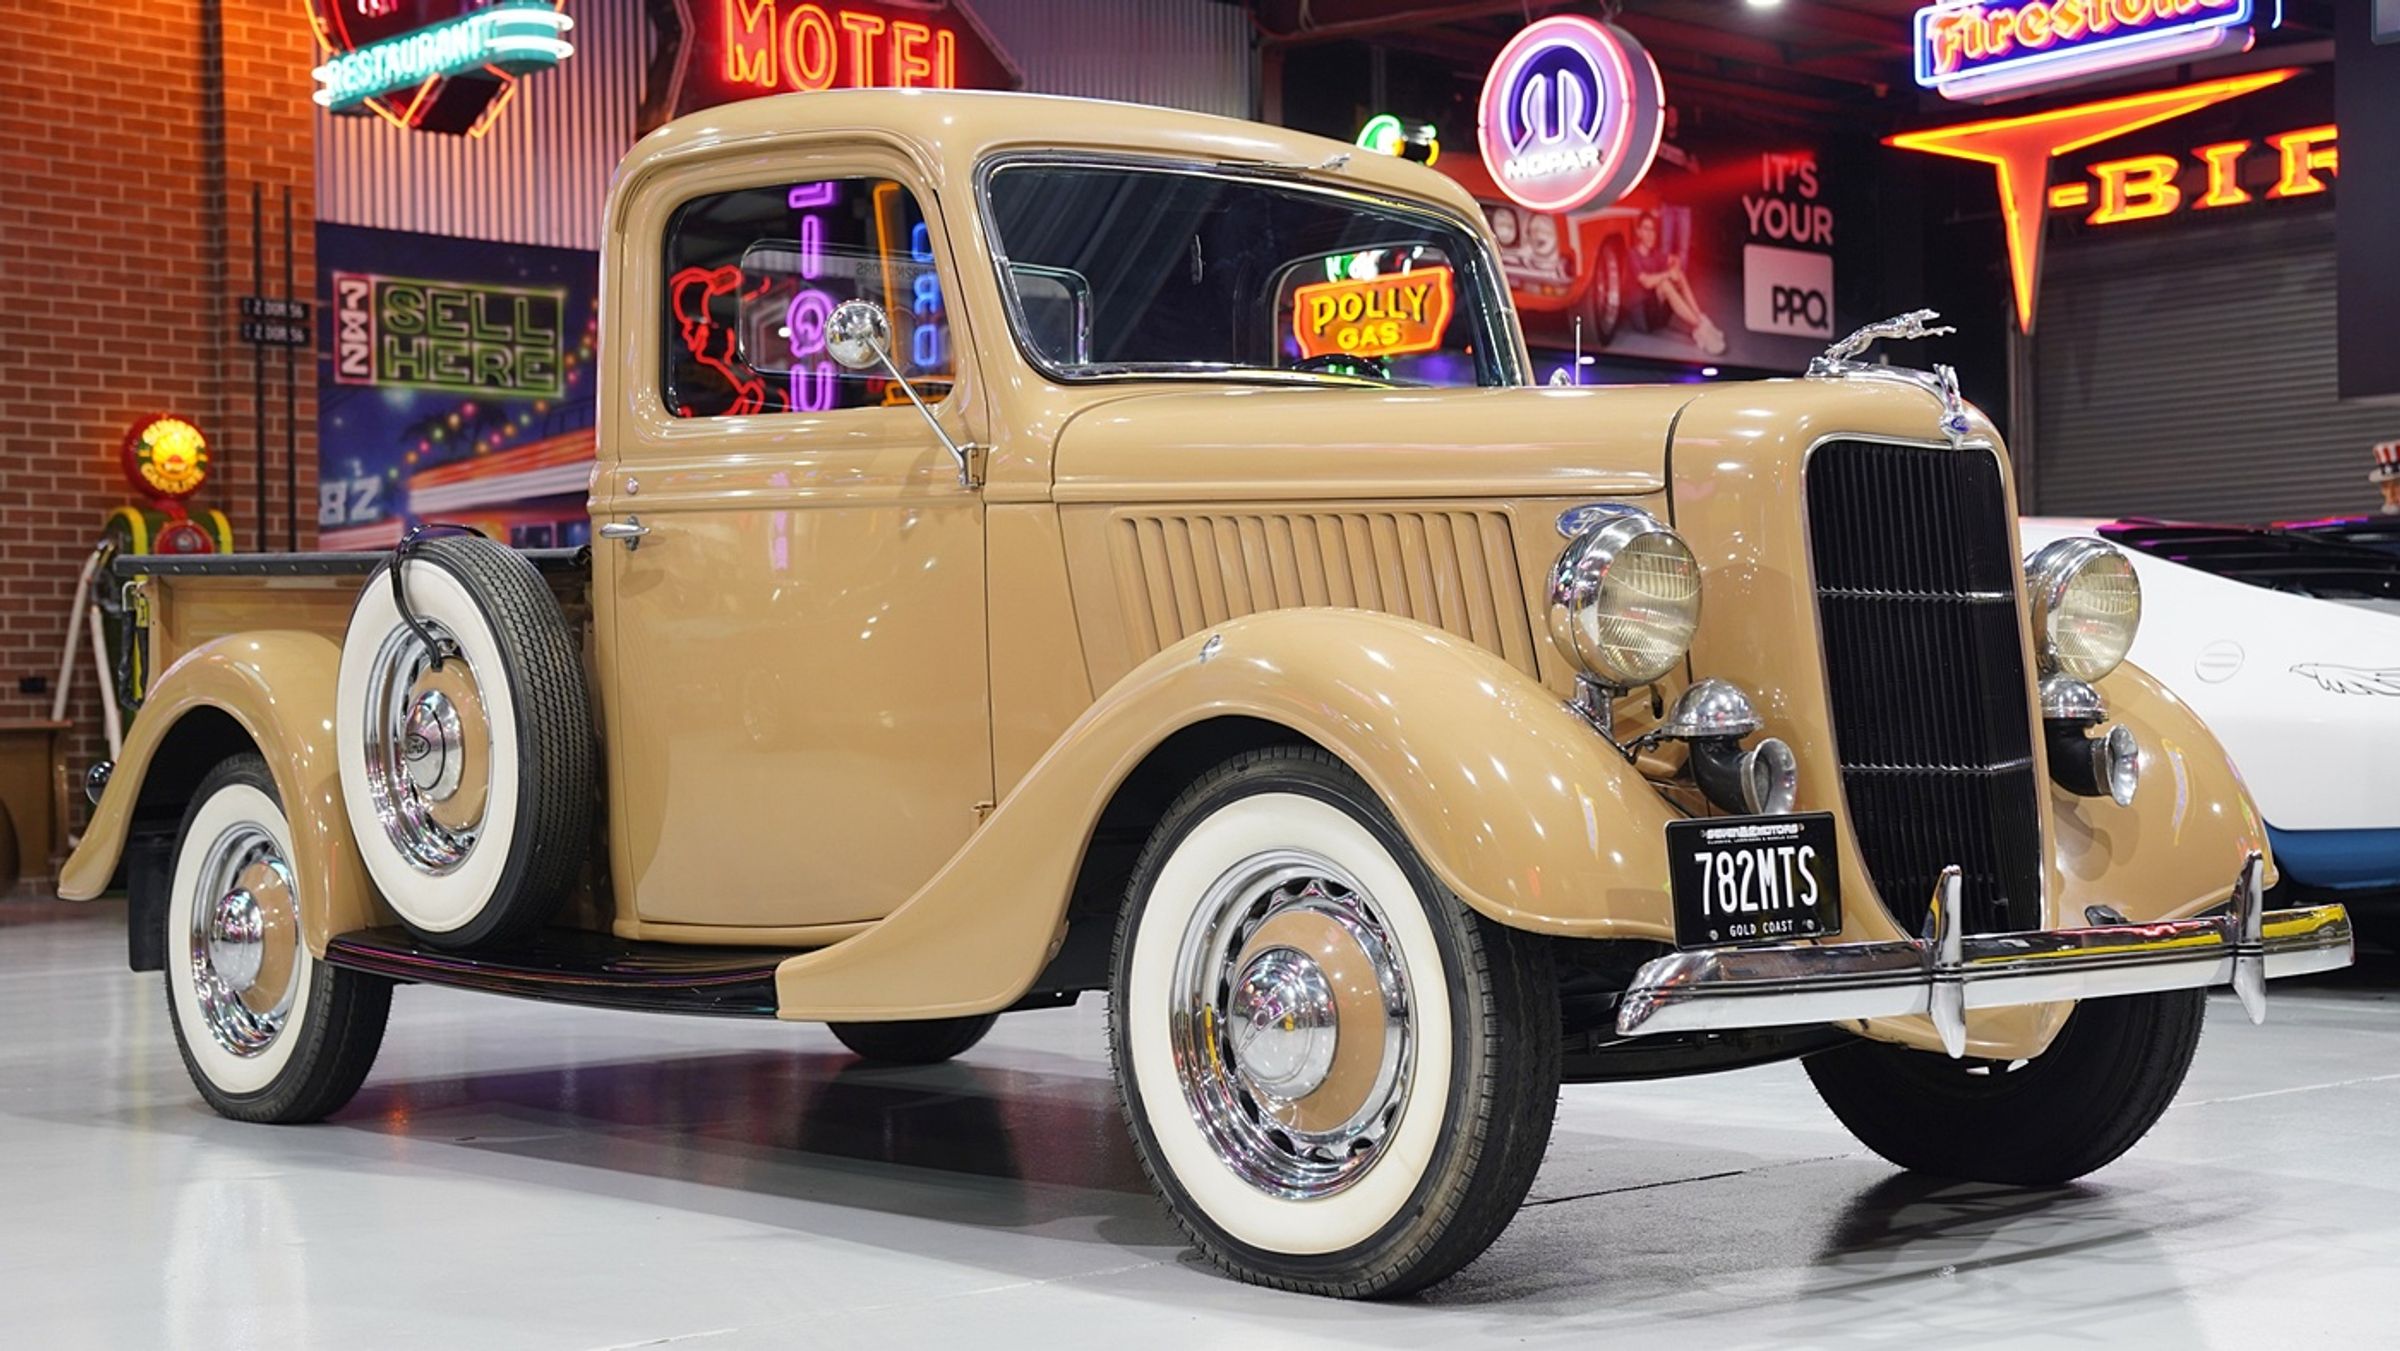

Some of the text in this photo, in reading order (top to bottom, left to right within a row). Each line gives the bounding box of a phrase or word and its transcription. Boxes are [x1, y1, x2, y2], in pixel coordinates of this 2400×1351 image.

[327, 14, 488, 93] RESTAURANT
[1504, 147, 1605, 181] MOPAR
[1763, 152, 1819, 199] IT'S
[1742, 194, 1834, 247] YOUR
[383, 284, 555, 346] SELL
[1310, 284, 1429, 335] POLLY
[1772, 284, 1829, 331] PPQ
[1337, 321, 1400, 350] GAS
[384, 334, 555, 392] HERE
[1694, 845, 1818, 916] 782MTS
[1729, 920, 1793, 937] GOLD COAST
